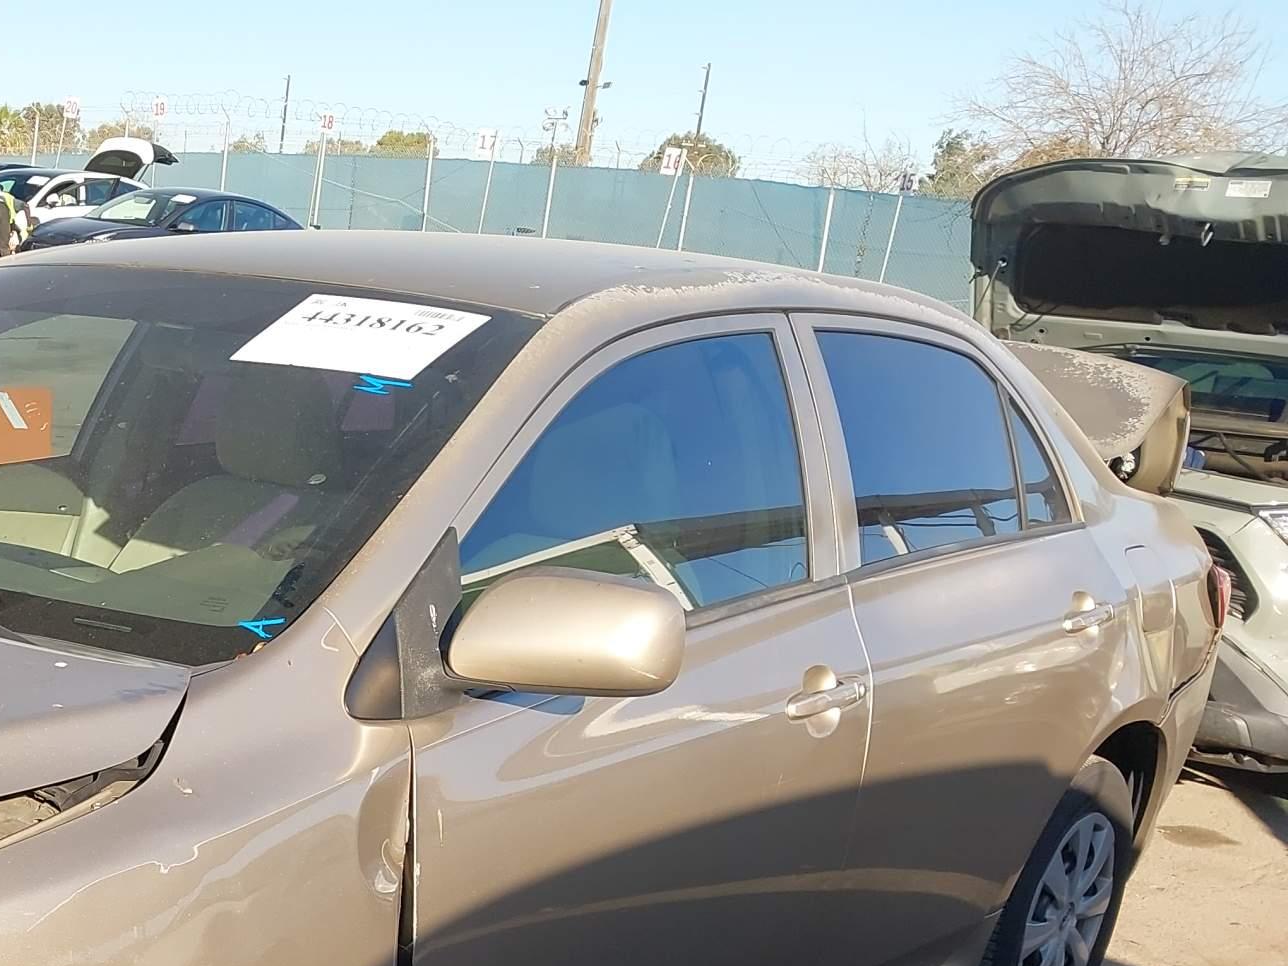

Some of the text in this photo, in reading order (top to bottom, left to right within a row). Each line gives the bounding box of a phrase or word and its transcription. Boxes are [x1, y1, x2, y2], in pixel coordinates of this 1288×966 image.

[65, 100, 78, 115] 20
[153, 102, 165, 116] 19
[321, 114, 334, 130] 18
[479, 135, 497, 150] 17
[899, 173, 914, 191] 15
[301, 310, 445, 337] 44318162
